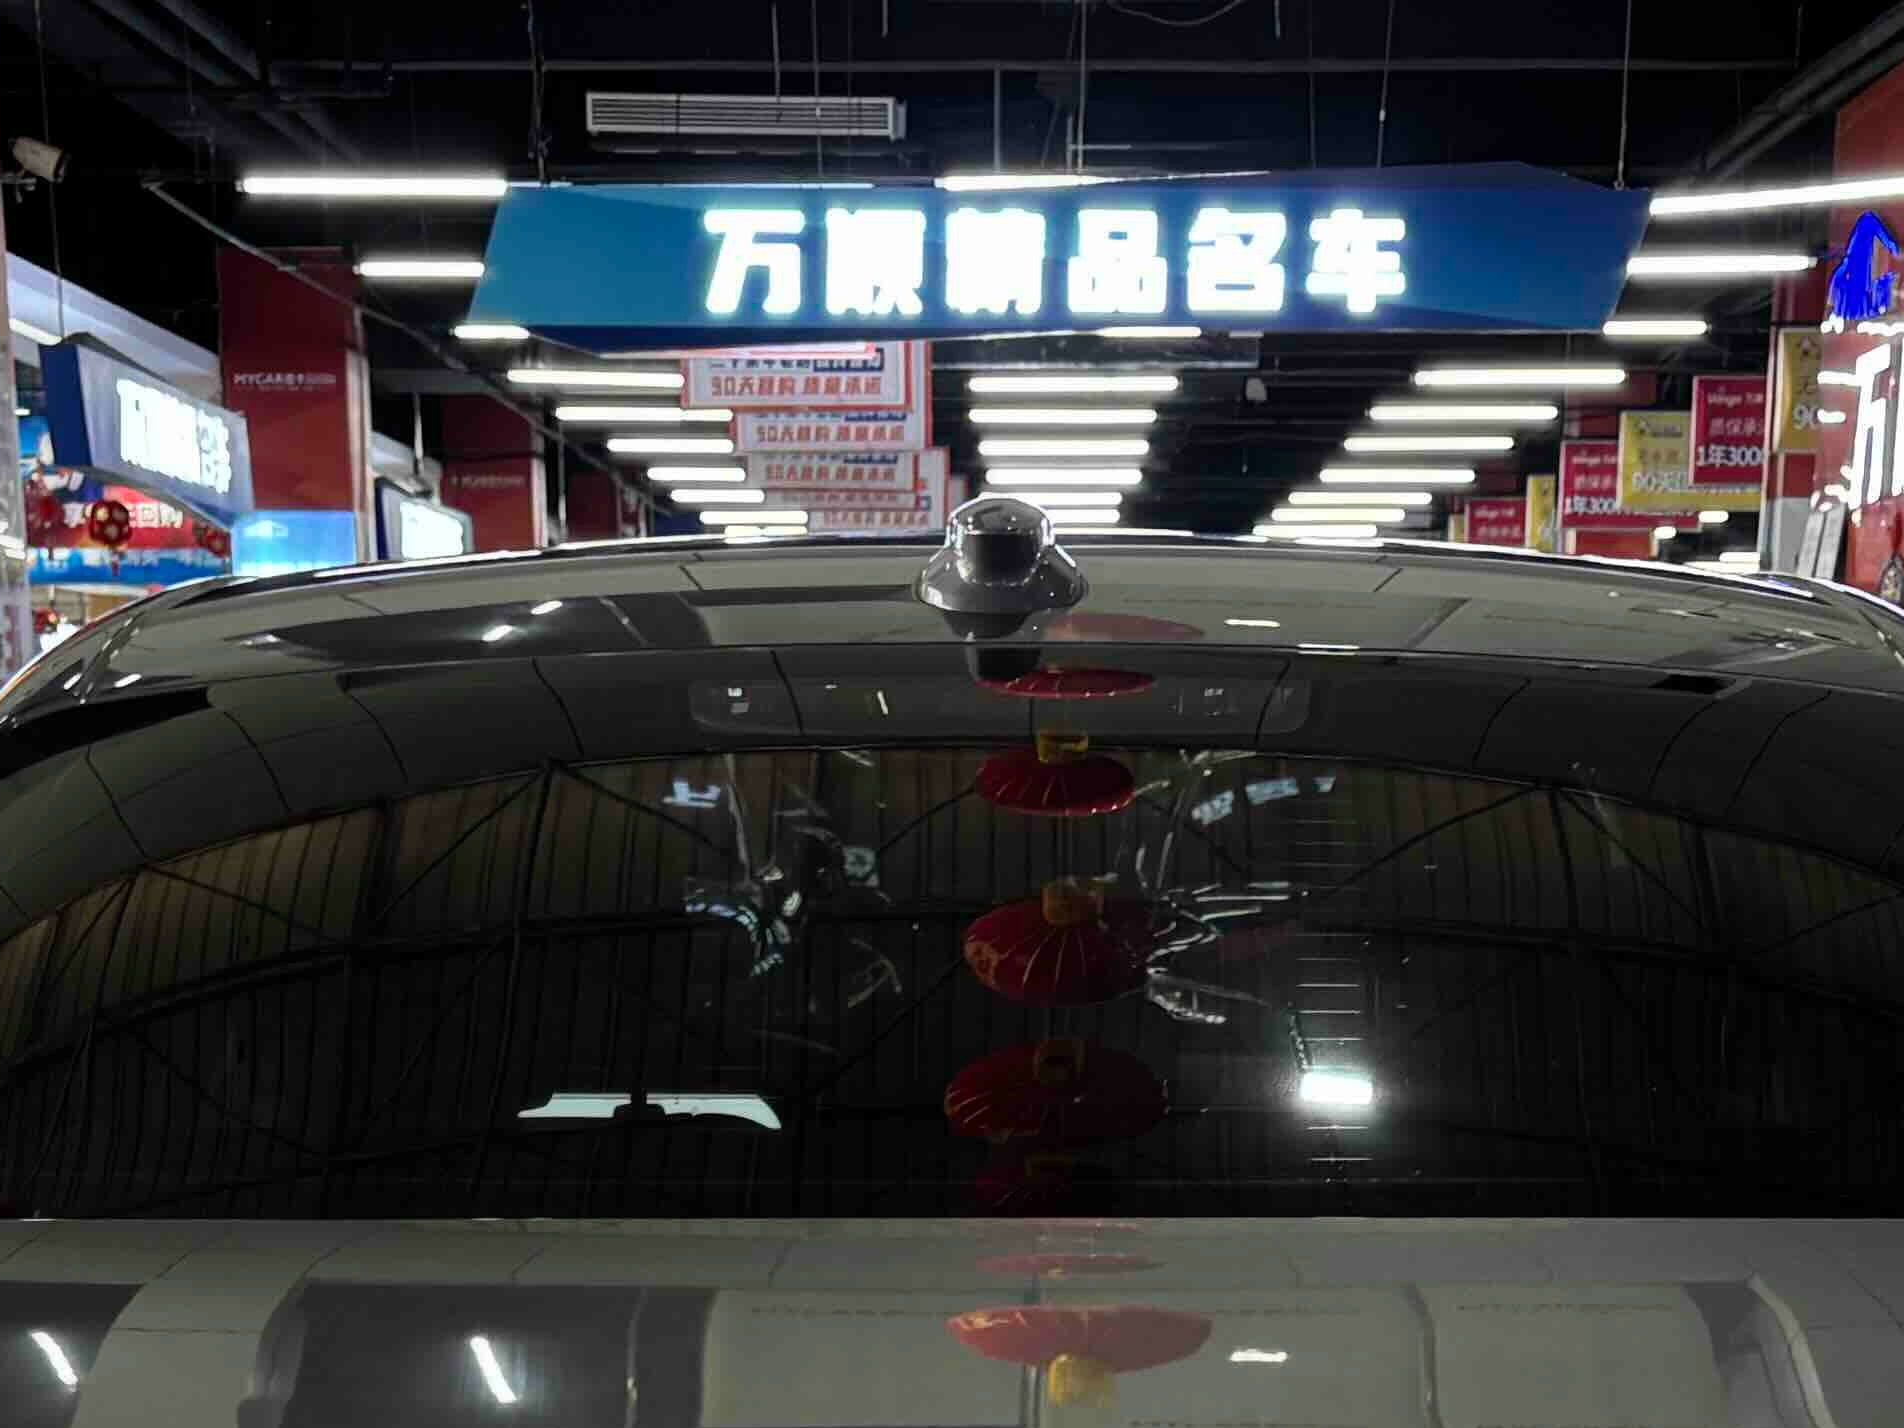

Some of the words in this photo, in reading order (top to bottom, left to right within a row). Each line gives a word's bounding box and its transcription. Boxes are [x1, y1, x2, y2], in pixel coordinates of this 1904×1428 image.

[703, 206, 1408, 316] 万顺精品名车
